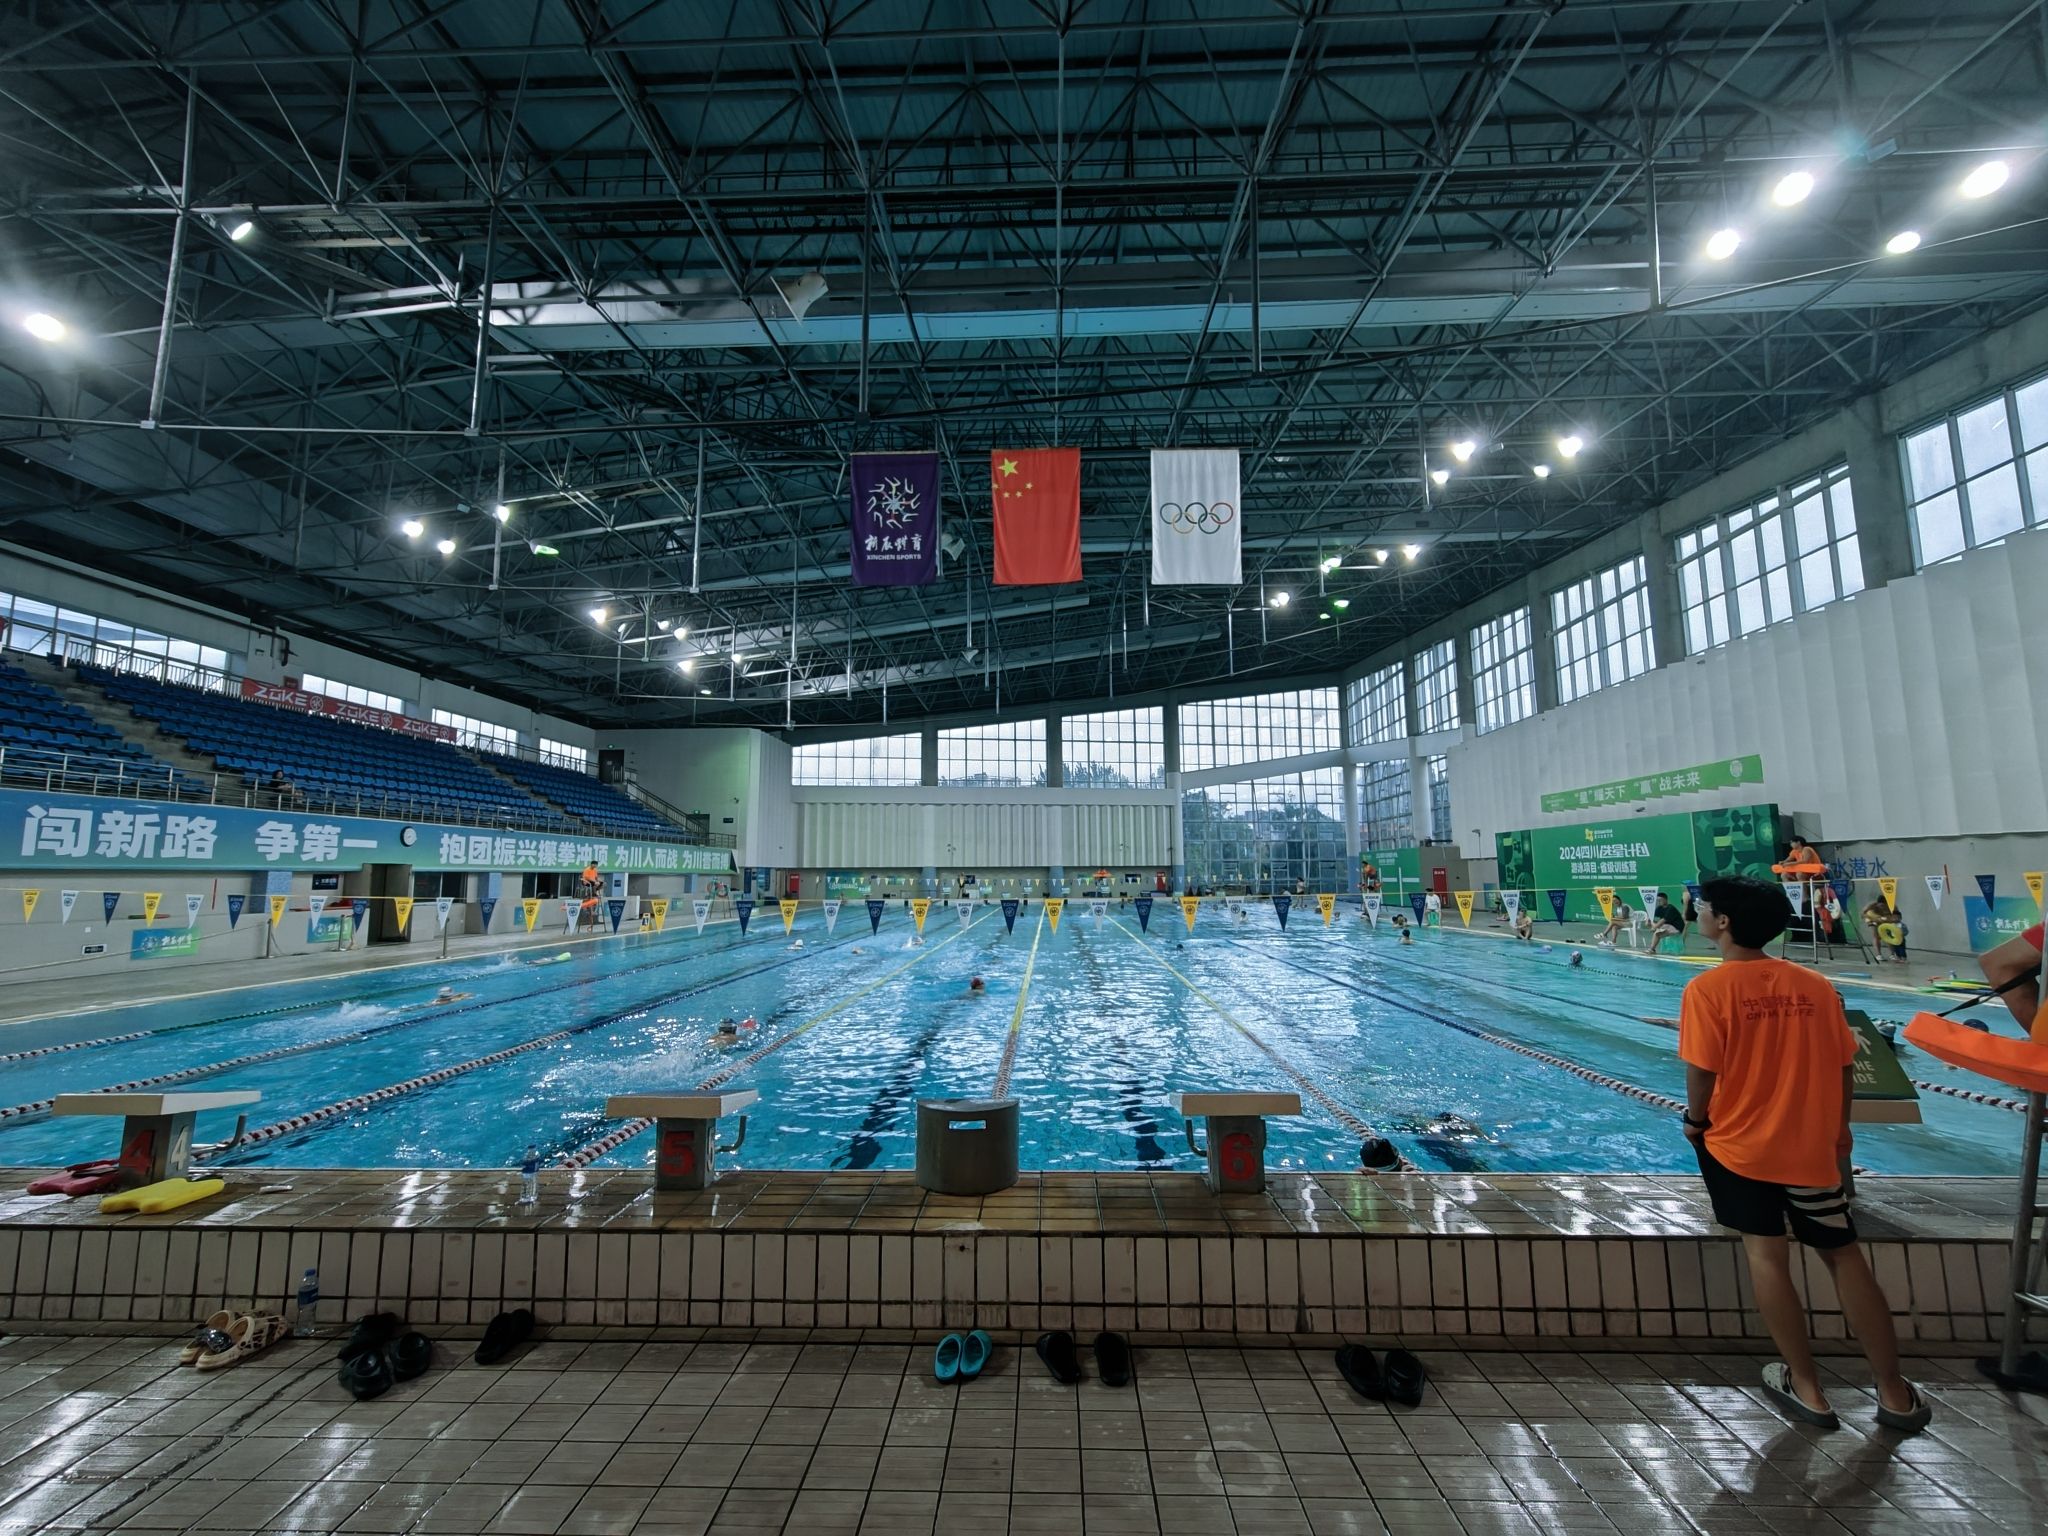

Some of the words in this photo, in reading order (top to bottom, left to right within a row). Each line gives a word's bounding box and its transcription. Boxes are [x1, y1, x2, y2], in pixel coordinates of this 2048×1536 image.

[21, 805, 218, 860] 闯新路
[255, 821, 378, 862] 争第一
[615, 845, 678, 869] 为川人而战
[1853, 1060, 1876, 1071] HE
[1853, 1073, 1877, 1084] IDE
[118, 1130, 156, 1175] 4
[169, 1125, 190, 1171] 4
[662, 1131, 696, 1177] 5
[1221, 1133, 1256, 1180] 6
